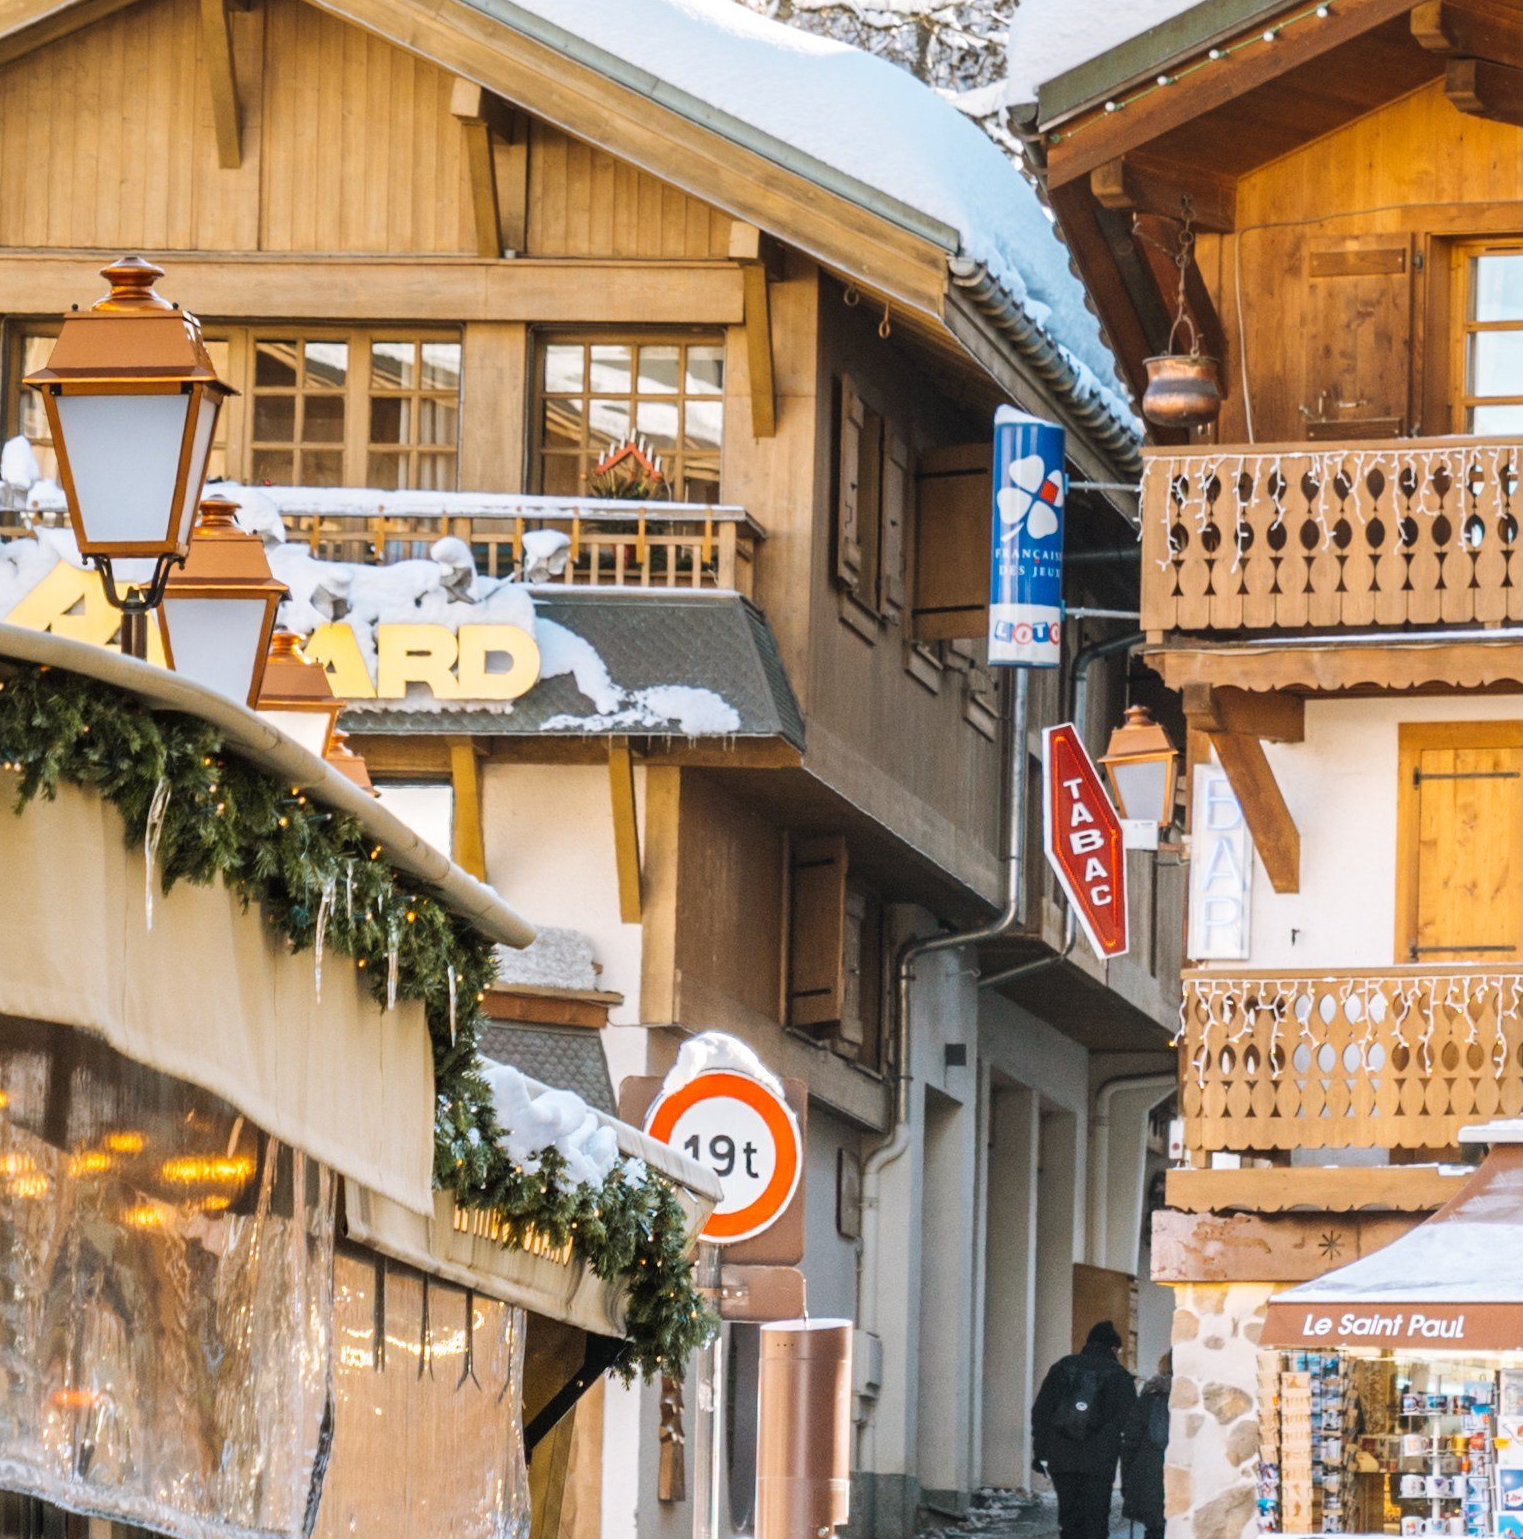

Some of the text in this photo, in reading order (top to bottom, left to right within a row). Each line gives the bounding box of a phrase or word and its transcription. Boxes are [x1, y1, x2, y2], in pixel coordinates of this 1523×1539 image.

[999, 564, 1060, 578] DES JEUX
[1063, 777, 1112, 906] TABAC
[1302, 1313, 1465, 1338] Le Saint Paul
